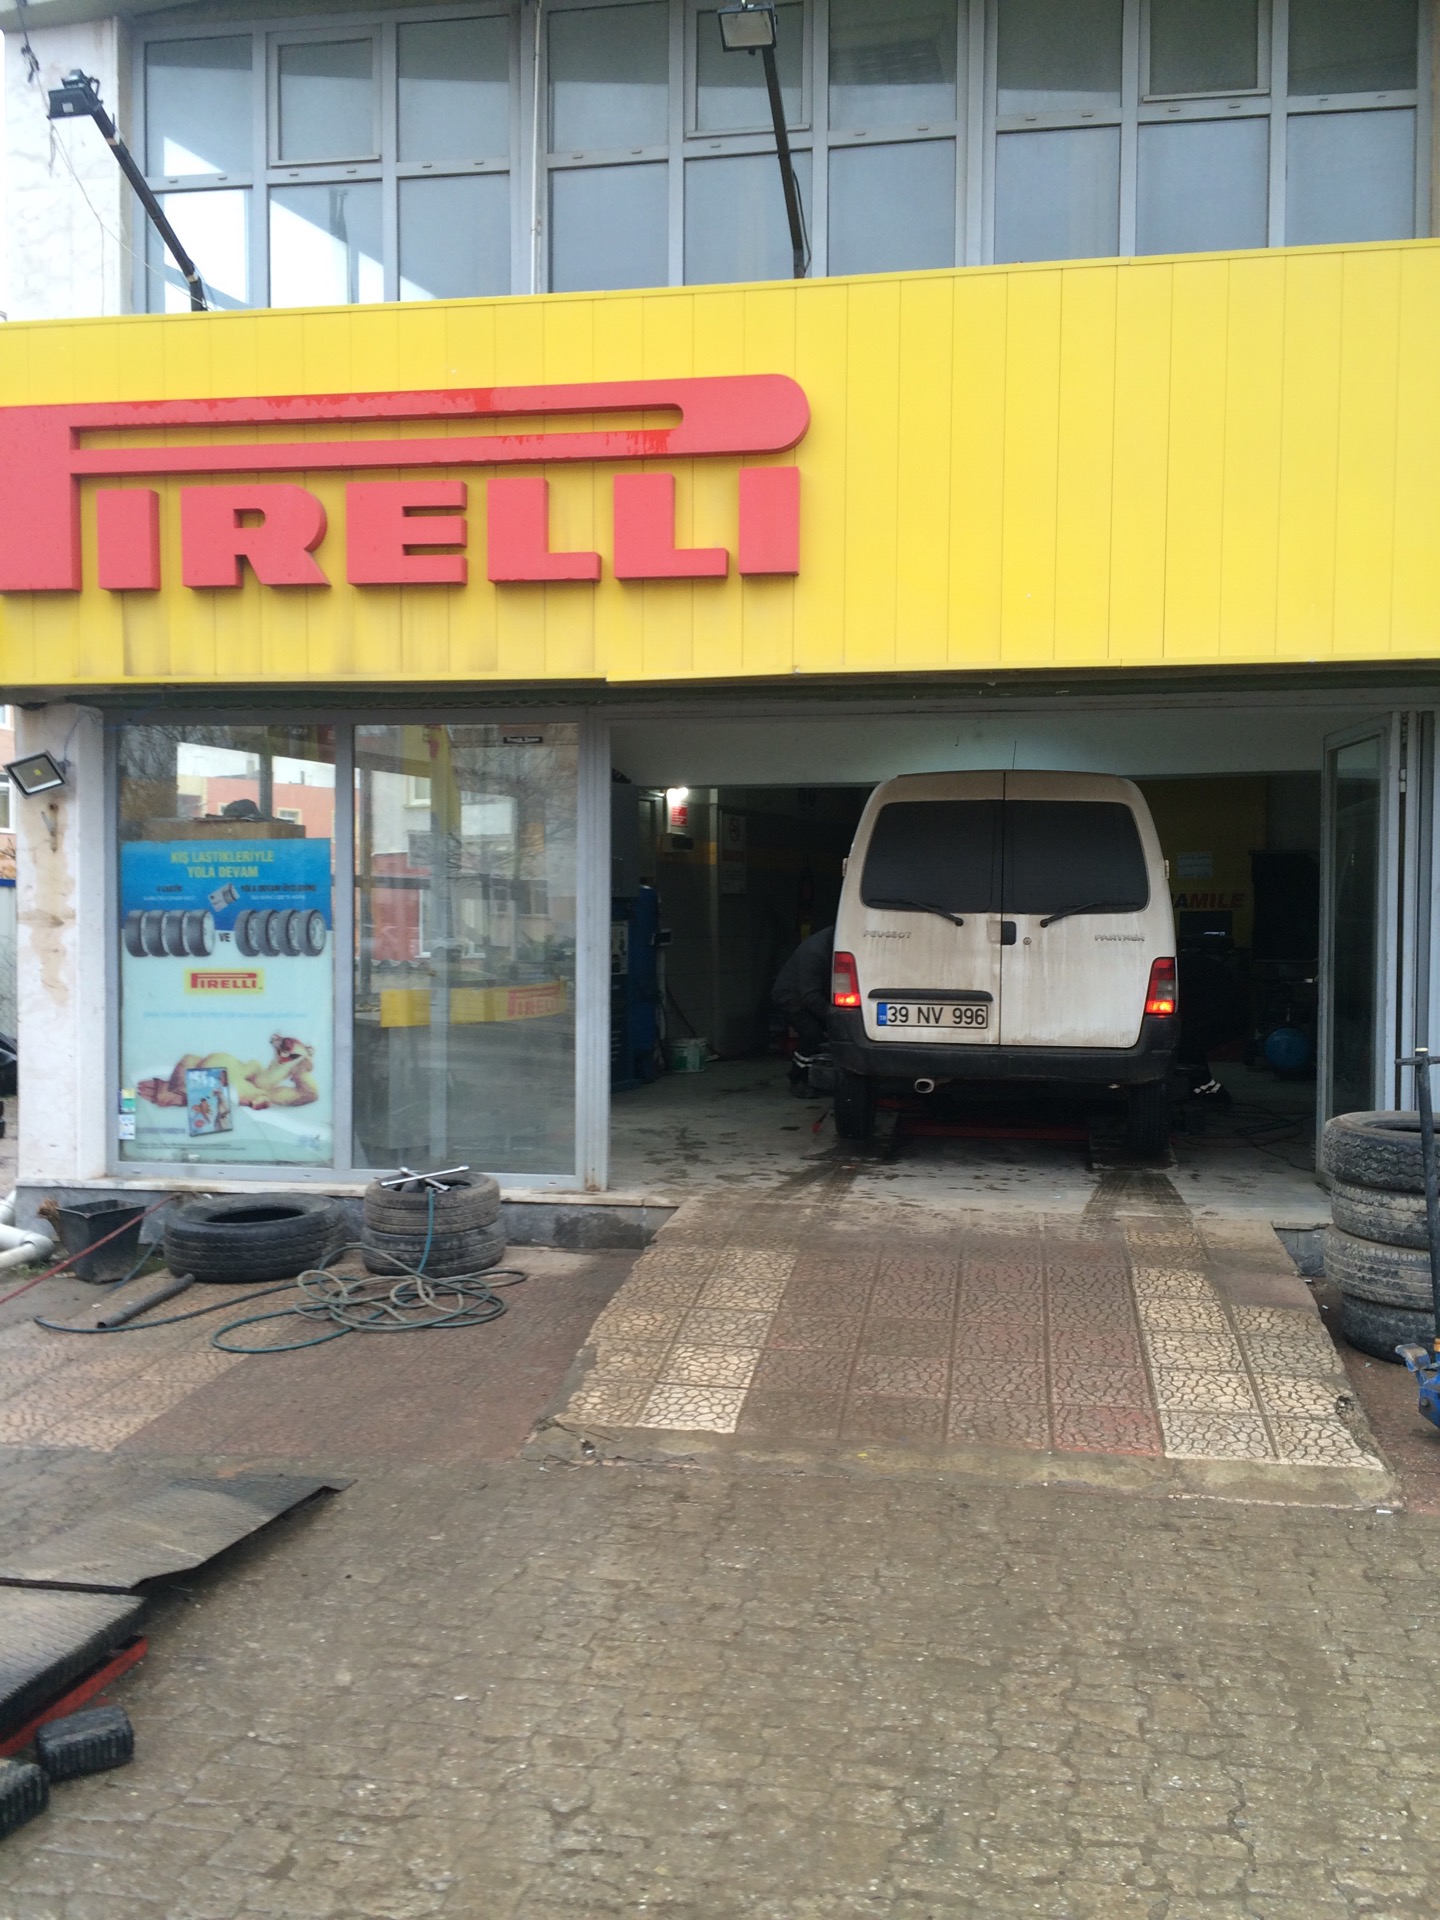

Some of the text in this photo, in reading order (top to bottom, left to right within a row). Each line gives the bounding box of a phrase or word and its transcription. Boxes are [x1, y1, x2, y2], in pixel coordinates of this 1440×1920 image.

[0, 374, 811, 593] PIRELLI
[187, 866, 259, 878] YOLA DEVAM
[218, 932, 231, 943] VE
[863, 930, 912, 939] PEUGEOT
[1094, 933, 1146, 942] PARTNER
[190, 972, 258, 989] PIRELLI
[887, 1006, 909, 1024] 39
[917, 1006, 944, 1025] NV
[952, 1007, 986, 1026] 996
